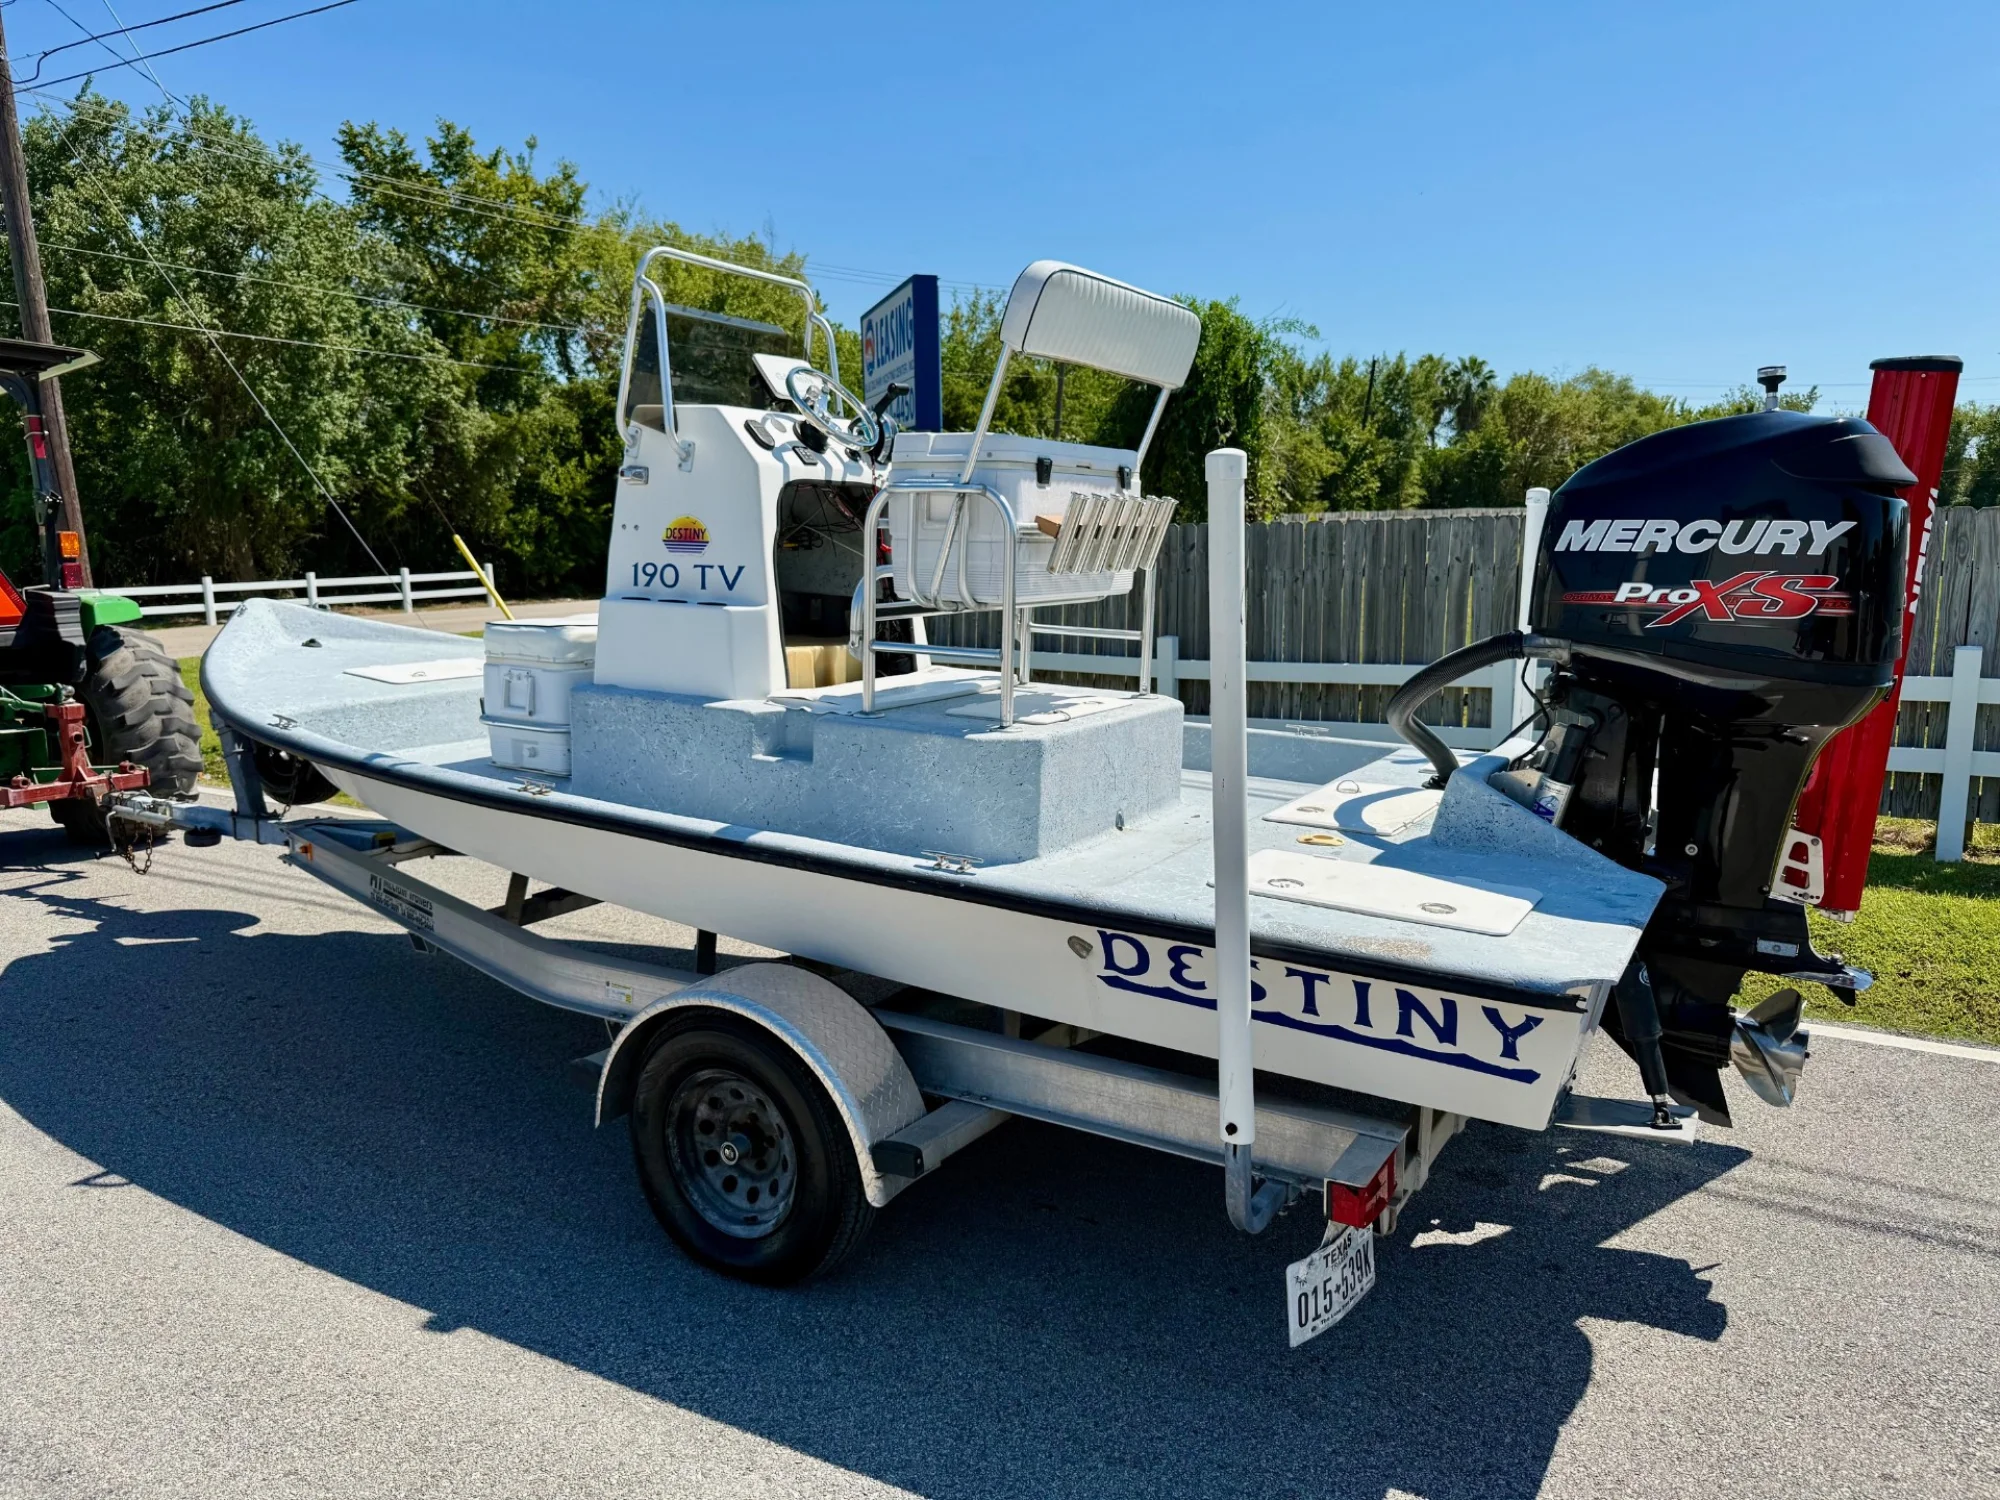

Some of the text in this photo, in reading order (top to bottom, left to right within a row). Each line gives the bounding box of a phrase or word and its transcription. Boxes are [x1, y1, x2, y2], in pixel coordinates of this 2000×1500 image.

[875, 297, 913, 368] LEASING
[665, 527, 707, 540] DESTINY
[1554, 519, 1857, 555] MERCURY
[632, 562, 746, 591] 190 TV
[1323, 1232, 1352, 1269] TEXAS
